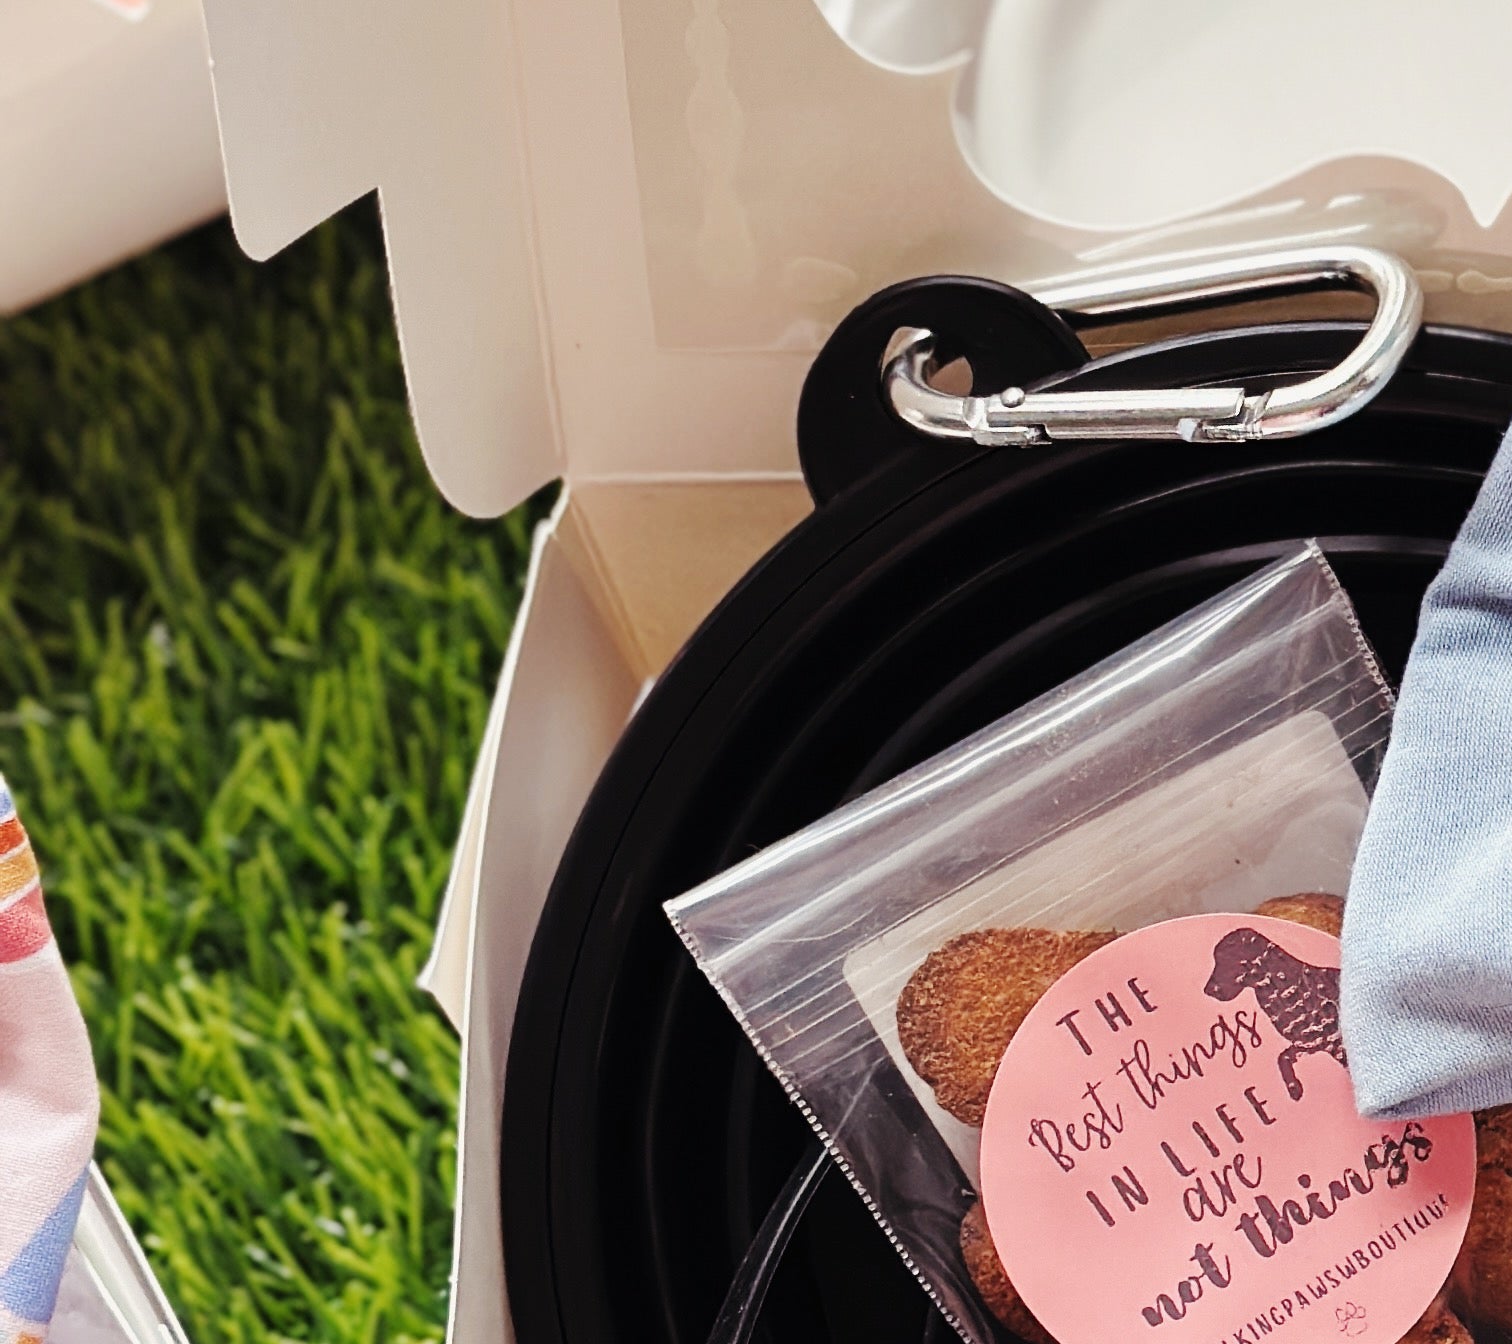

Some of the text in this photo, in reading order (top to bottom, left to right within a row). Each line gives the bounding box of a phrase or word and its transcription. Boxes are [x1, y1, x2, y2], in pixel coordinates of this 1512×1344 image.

[1055, 976, 1159, 1057] THE
[1027, 1007, 1264, 1173] Best things
[1085, 1085, 1277, 1228] IN LIFE
[1139, 1120, 1434, 1328] not things
[1182, 1152, 1264, 1223] are
